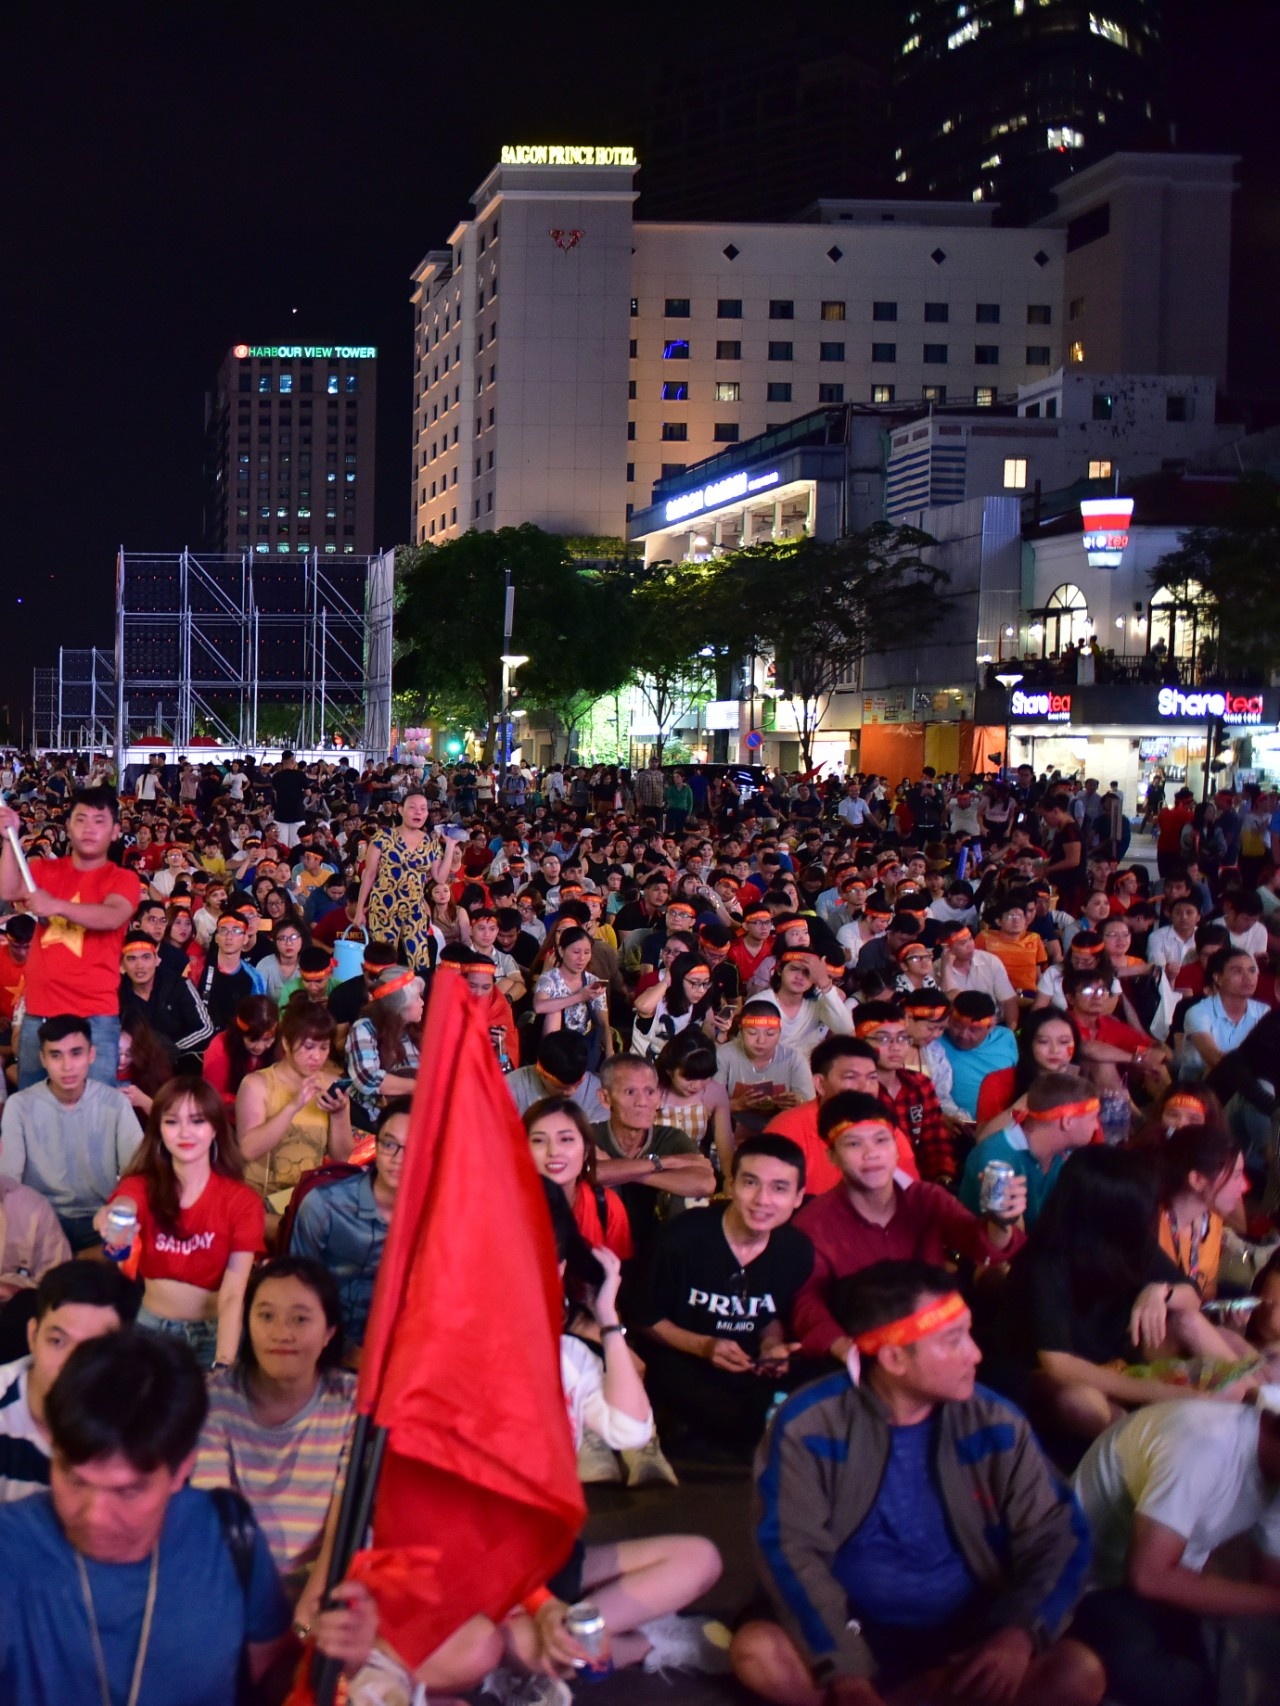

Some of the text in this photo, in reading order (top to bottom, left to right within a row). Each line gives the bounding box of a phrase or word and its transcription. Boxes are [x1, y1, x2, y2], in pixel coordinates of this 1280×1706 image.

[501, 145, 637, 165] SAIGON PRINCE HOTEL
[248, 347, 376, 359] HARBOUR VIEW TOWER
[1158, 687, 1264, 717] Sharetea
